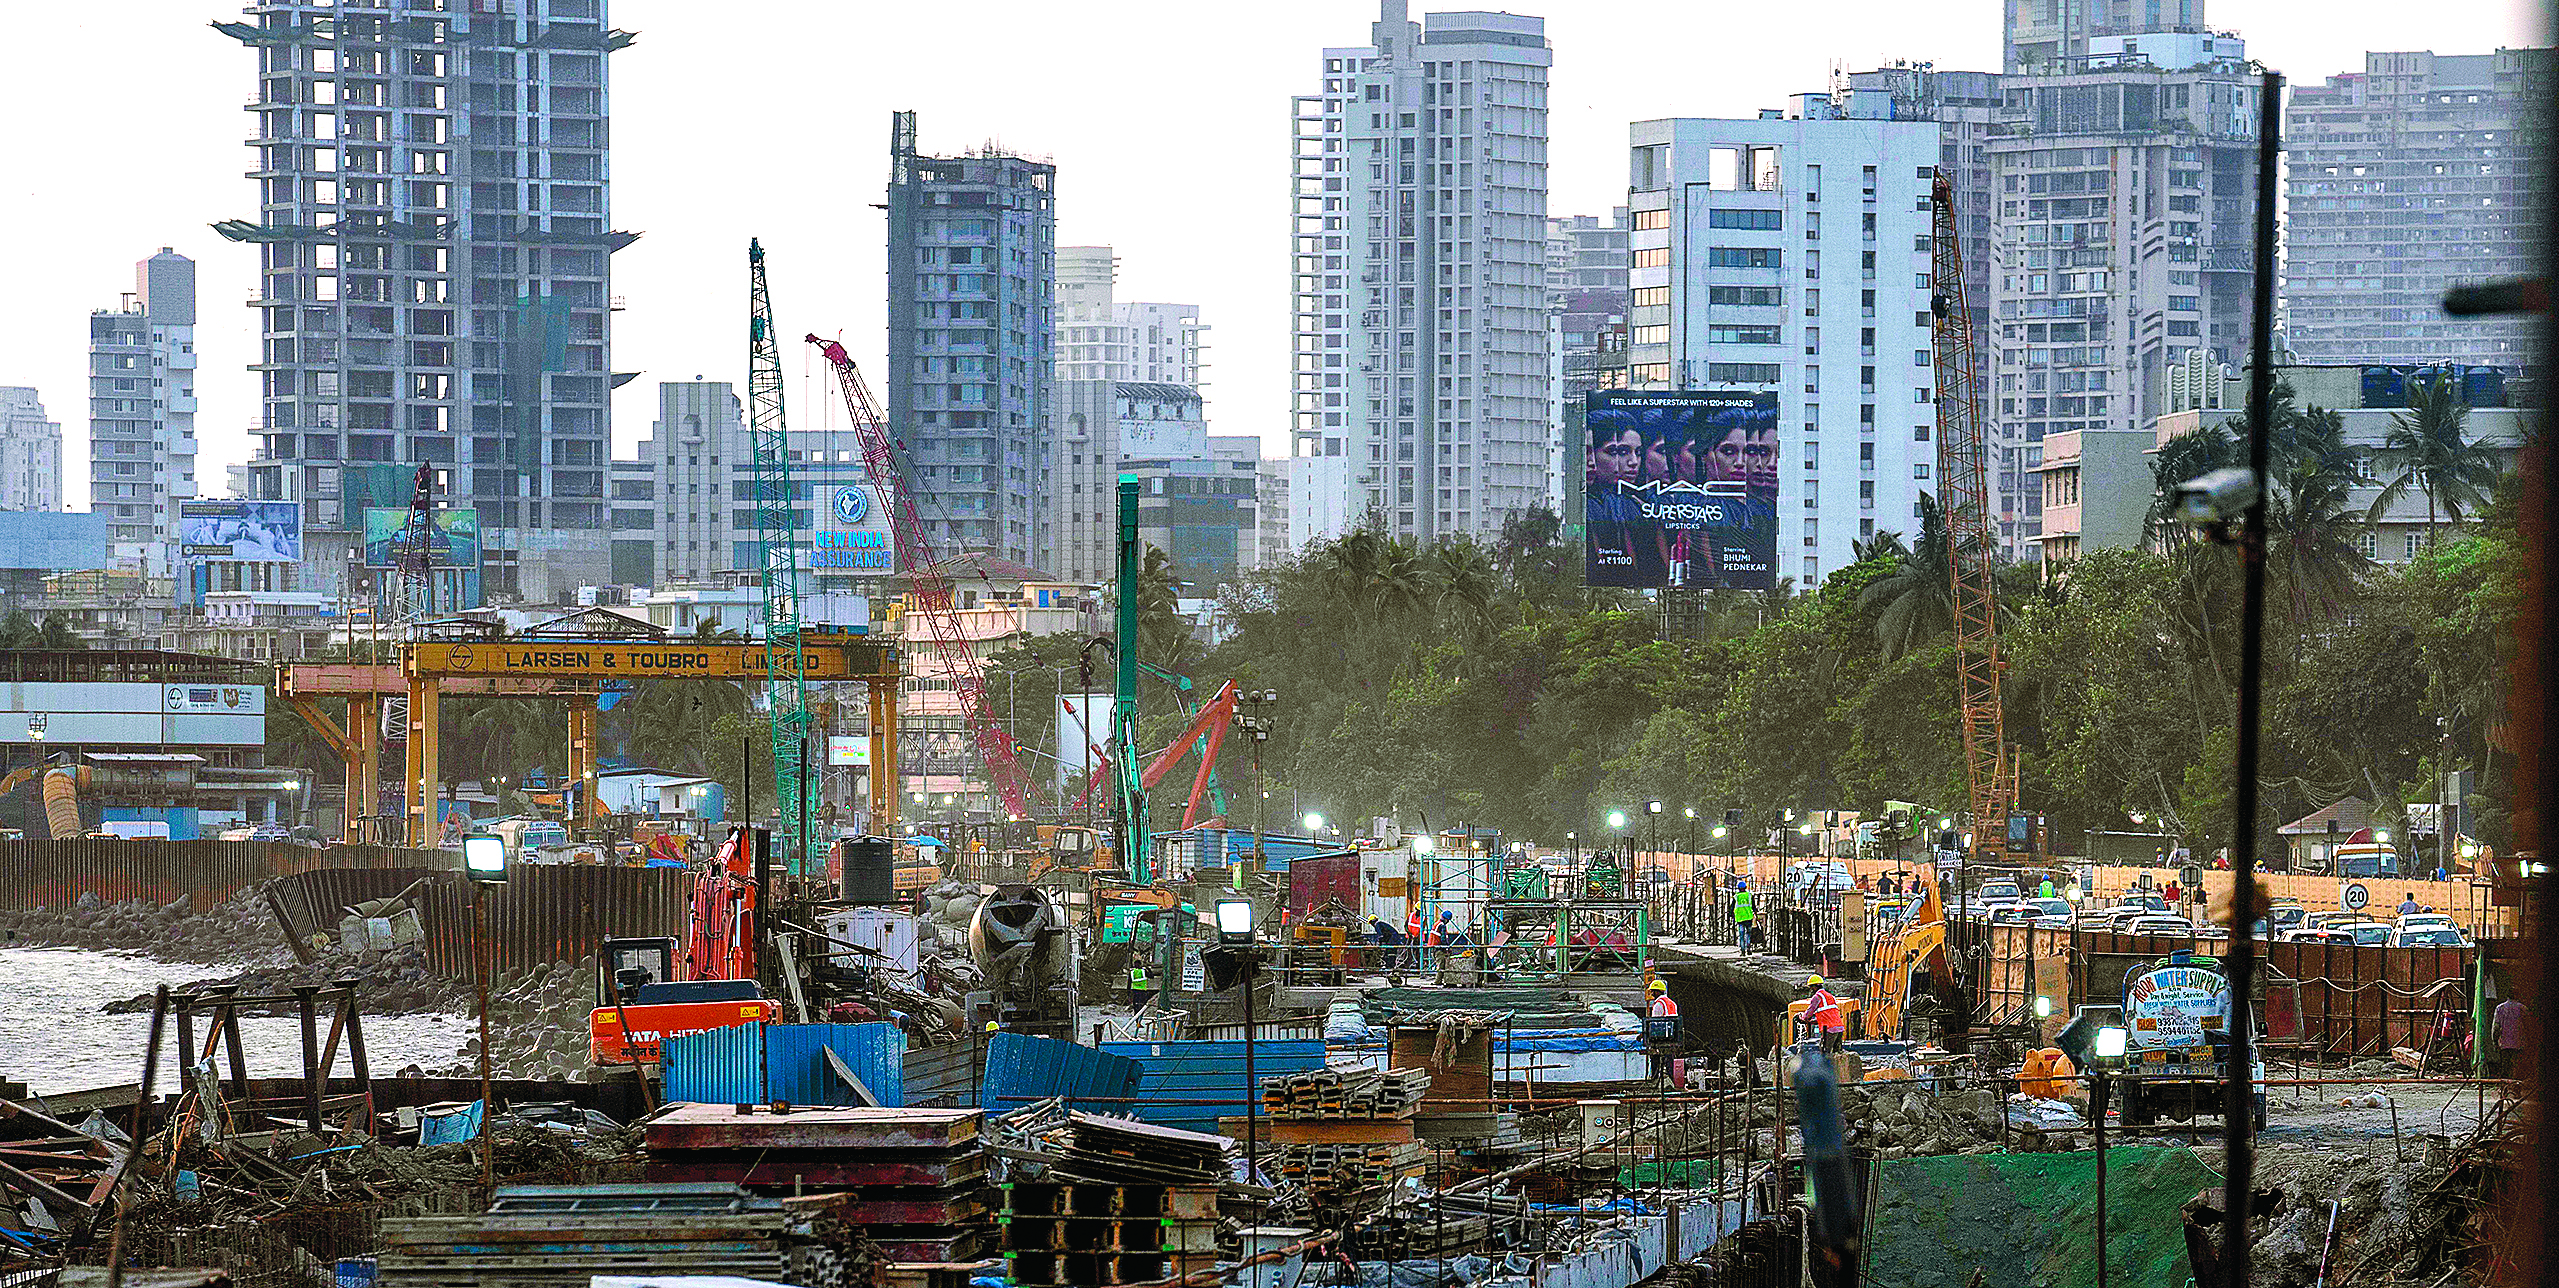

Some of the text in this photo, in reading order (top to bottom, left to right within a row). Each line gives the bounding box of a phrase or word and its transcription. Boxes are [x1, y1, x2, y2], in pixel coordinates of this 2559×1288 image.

[1610, 398, 1627, 406] FEEL
[1627, 398, 1642, 406] LIKE
[1649, 398, 1689, 406] SUPERSTAR
[1689, 399, 1708, 407] WITH
[1708, 399, 1724, 407] 120+
[1724, 399, 1754, 408] SHADES
[1641, 502, 1723, 522] SUPERSTARS
[1665, 522, 1700, 530] LIPSTICKS
[815, 530, 885, 548] NEW INDIA
[1598, 548, 1623, 556] Starting
[1723, 546, 1746, 554] Starring
[808, 551, 892, 568] ASSURANCE
[1606, 556, 1633, 566] ₹1100
[1723, 554, 1751, 562] BHUMI
[1723, 563, 1768, 571] PEDNEKAR
[506, 652, 590, 668] LARSEN
[602, 652, 617, 668] &
[626, 652, 709, 669] TOUBRO
[1786, 872, 1801, 883] 20
[2349, 890, 2365, 903] 20
[2154, 970, 2188, 990] WATER
[2188, 970, 2226, 998] SUPPLY
[622, 1030, 661, 1043] TATA
